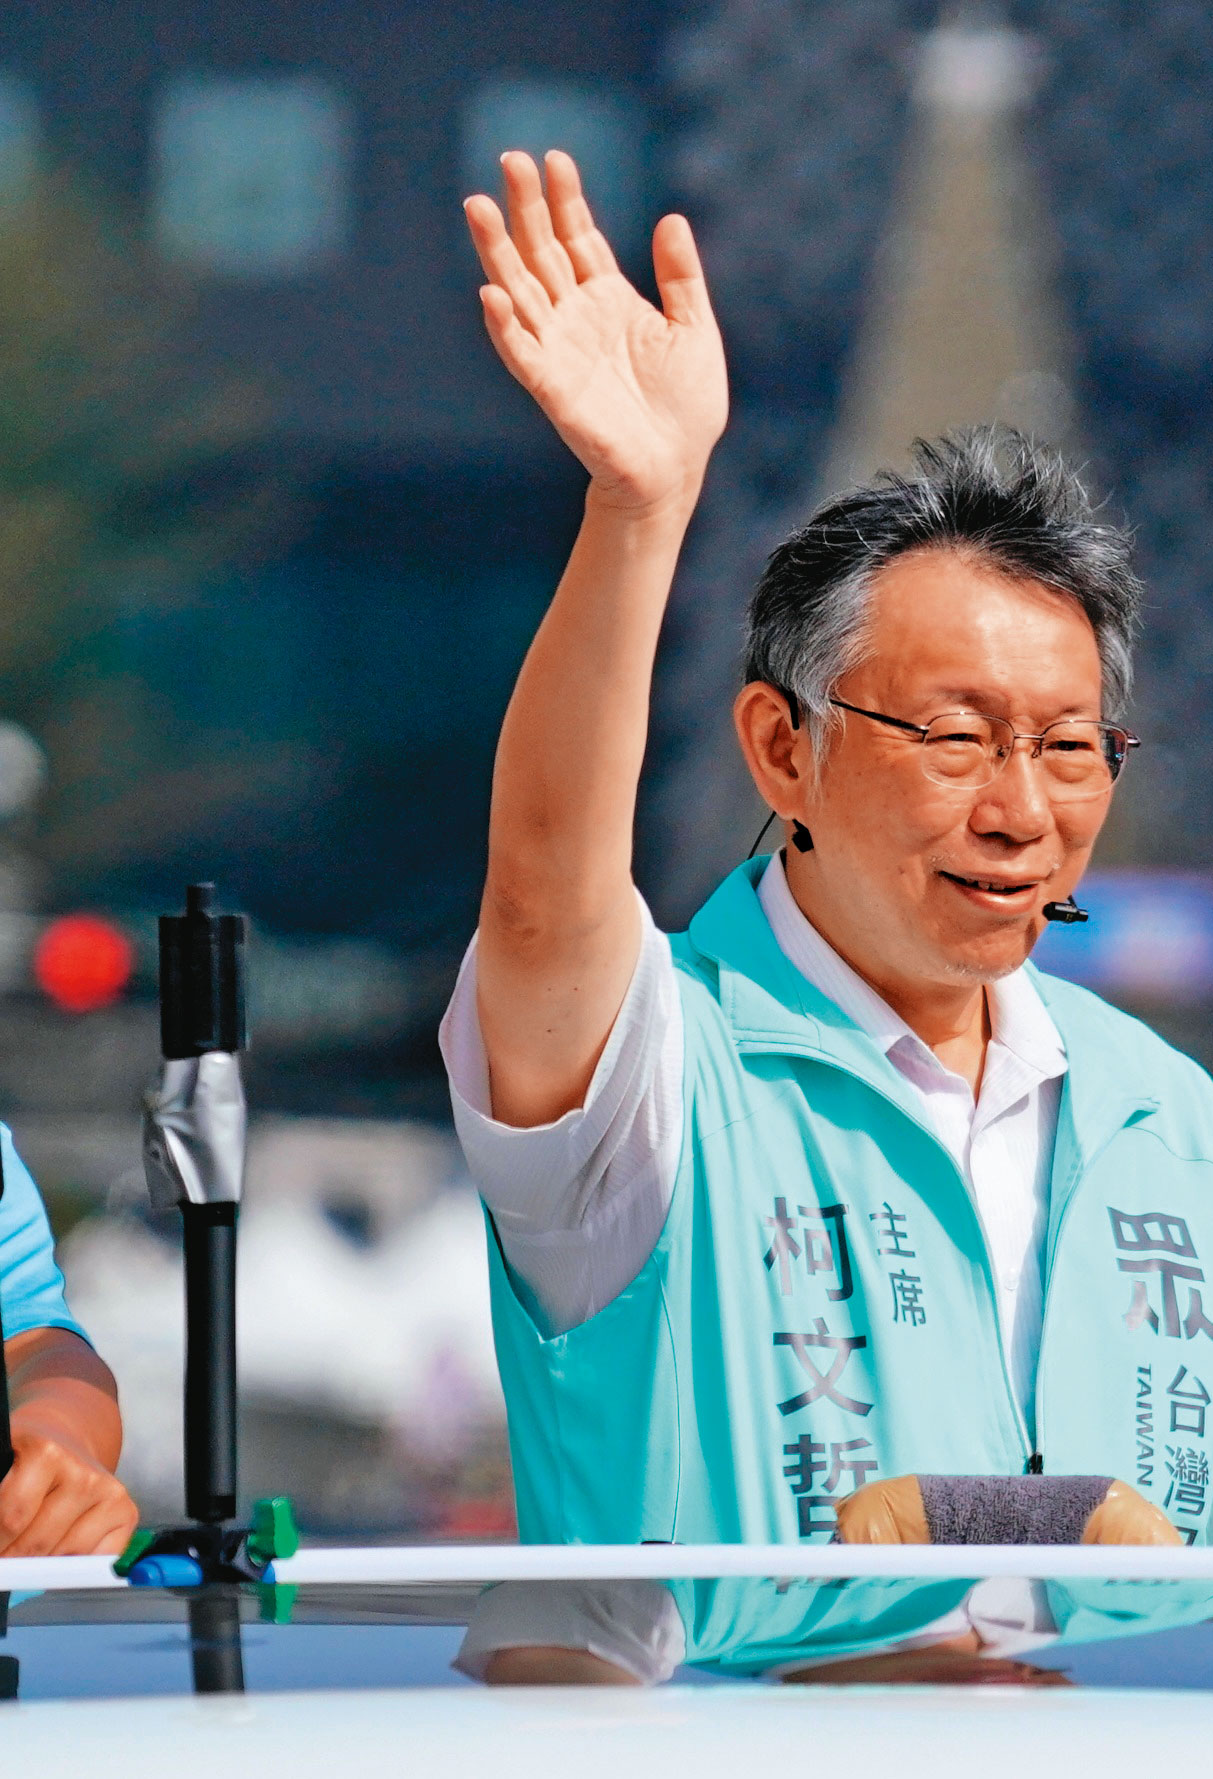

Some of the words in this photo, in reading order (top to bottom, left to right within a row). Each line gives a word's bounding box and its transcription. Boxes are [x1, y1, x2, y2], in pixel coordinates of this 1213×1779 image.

[869, 1202, 926, 1327] 主席
[763, 1196, 879, 1537] 柯文哲
[1136, 1363, 1154, 1487] TAIWAN
